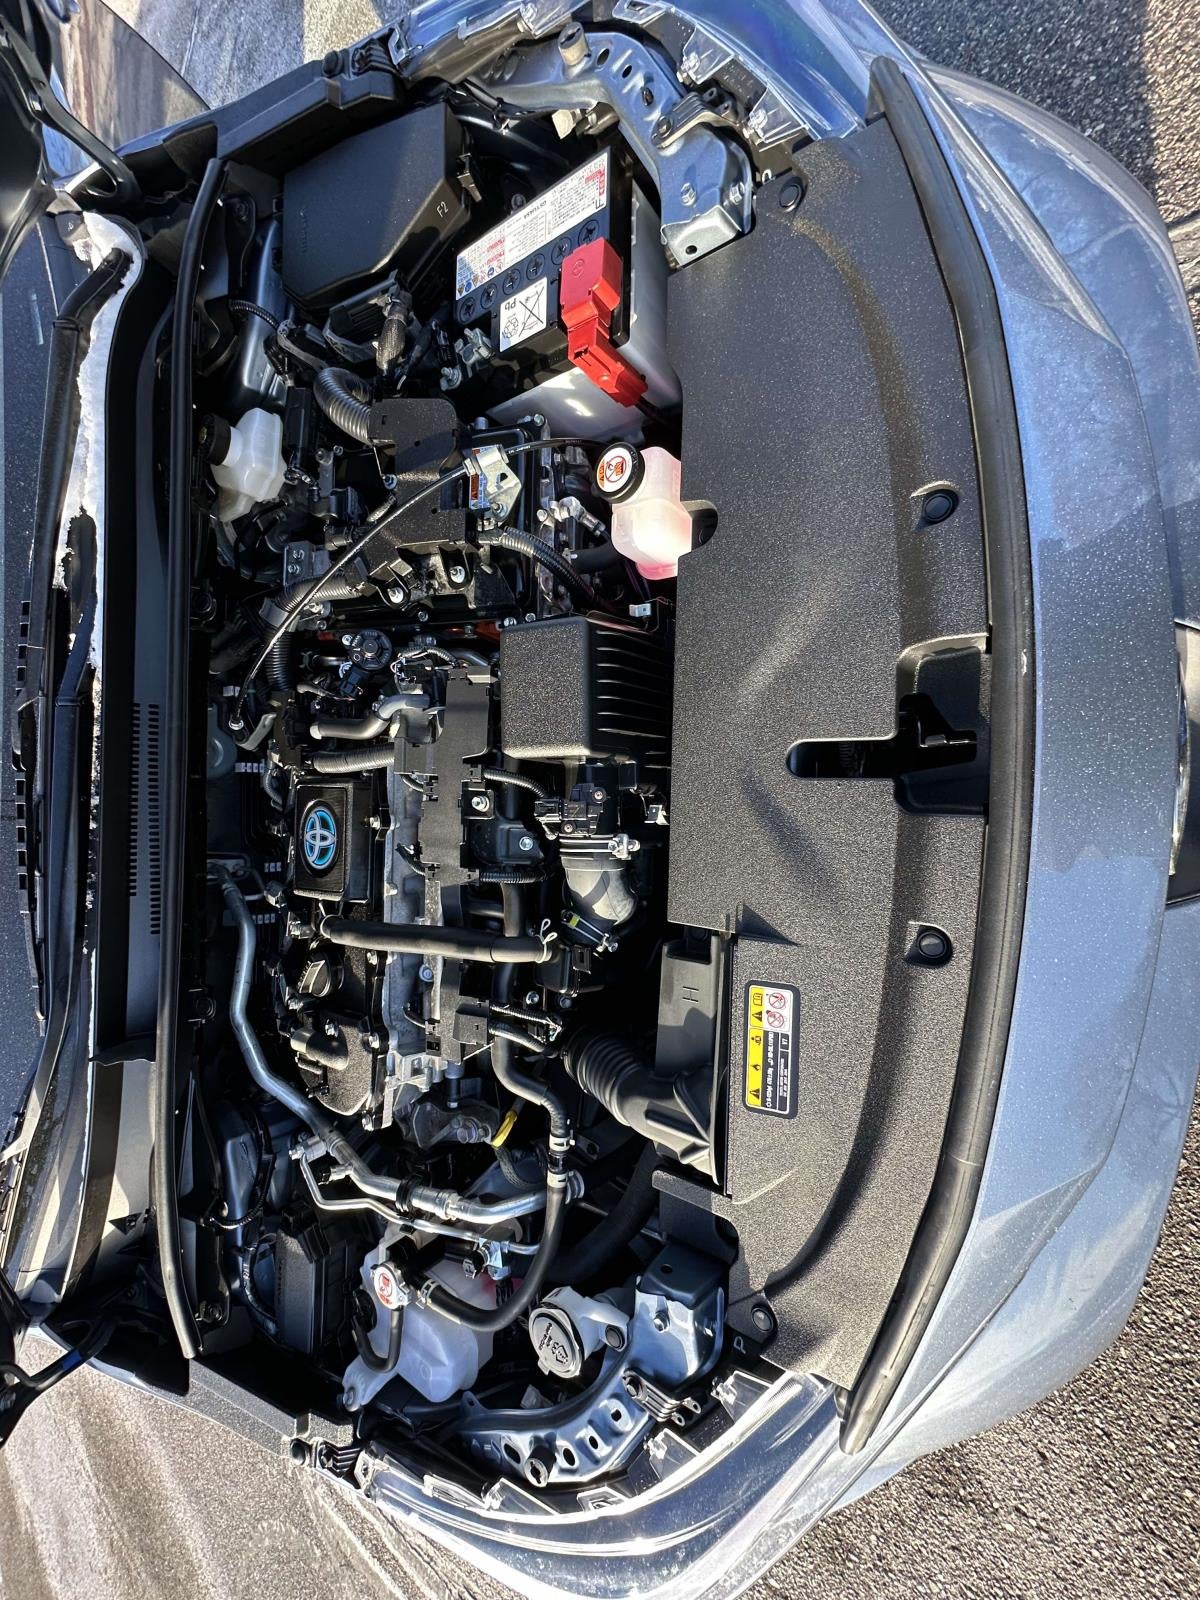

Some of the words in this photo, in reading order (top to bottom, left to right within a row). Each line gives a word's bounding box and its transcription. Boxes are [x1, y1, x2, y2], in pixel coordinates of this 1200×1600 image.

[436, 201, 449, 218] F2
[504, 298, 517, 311] Pb
[681, 986, 699, 1004] H
[733, 1336, 746, 1354] P
